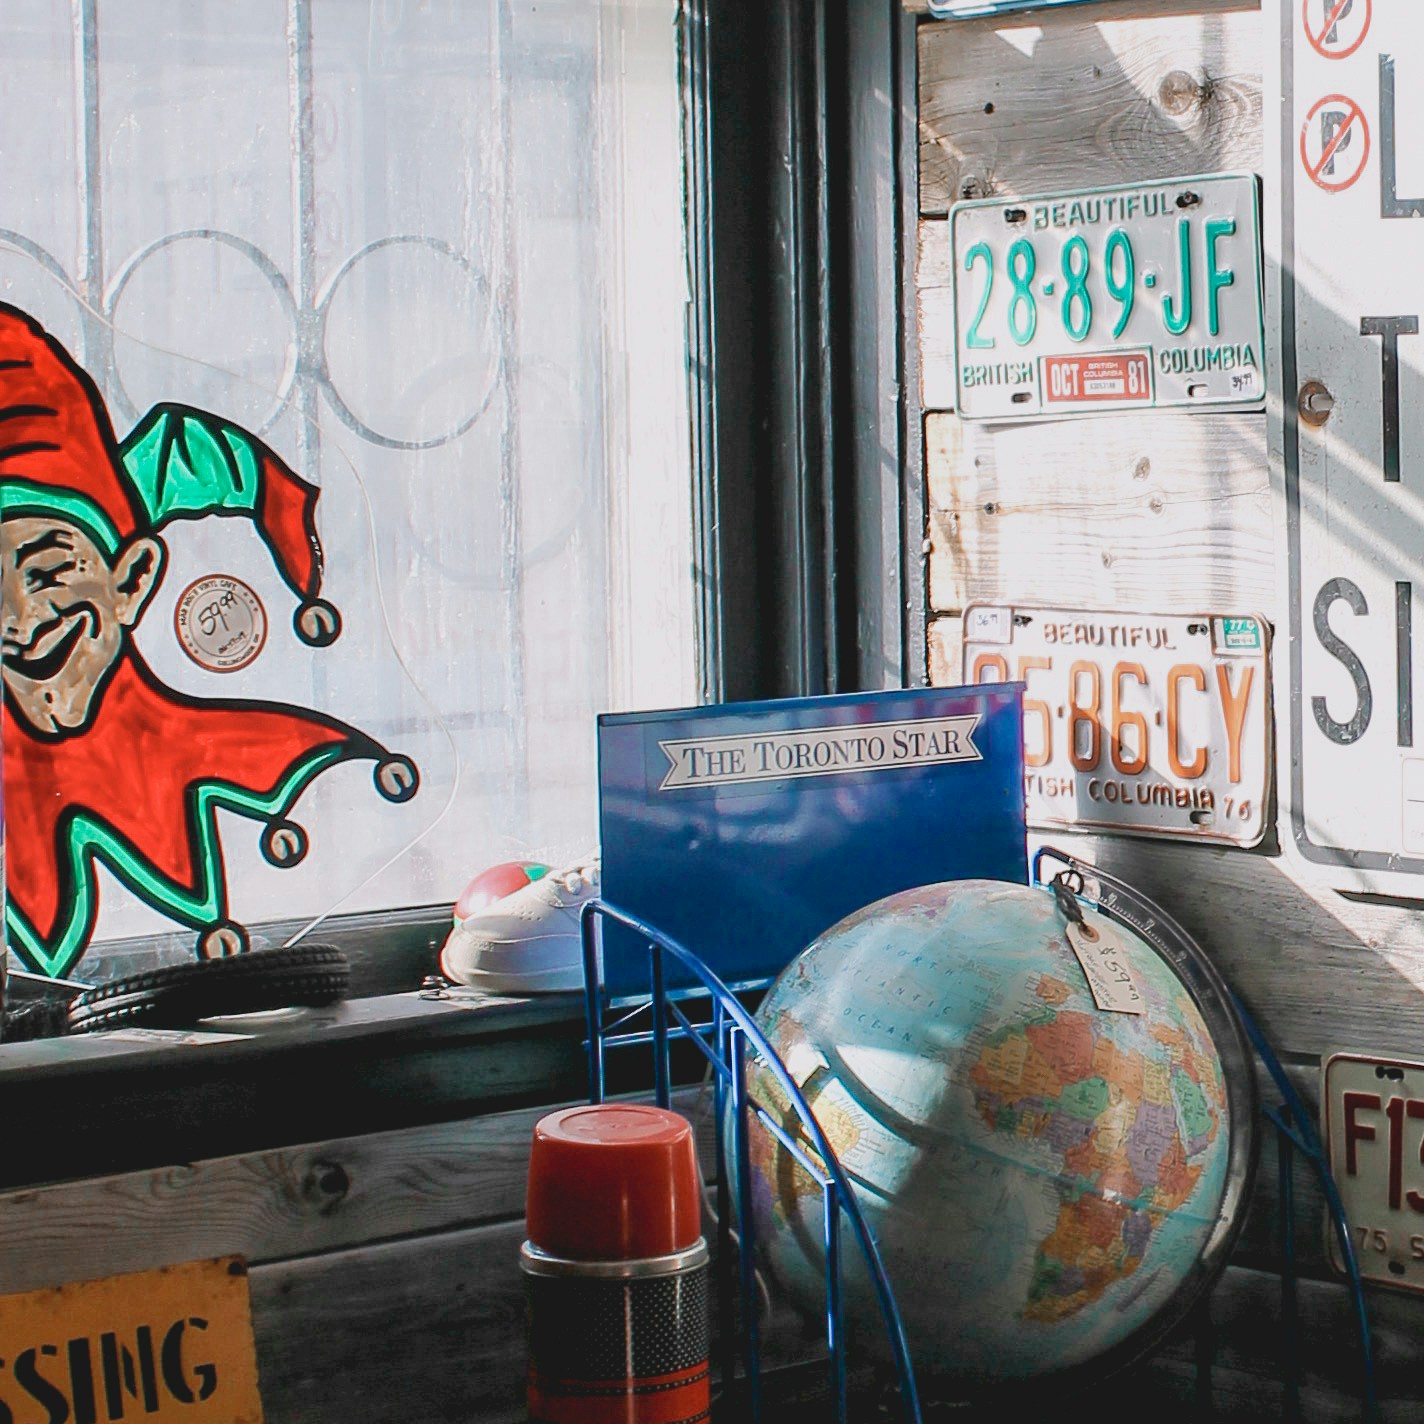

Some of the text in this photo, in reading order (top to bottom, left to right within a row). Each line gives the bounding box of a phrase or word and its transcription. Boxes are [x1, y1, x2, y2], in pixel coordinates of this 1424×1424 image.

[1033, 190, 1174, 231] BEAUTIFUL
[963, 342, 1257, 387] BRITISH COLUMBIA
[1051, 360, 1146, 396] OCT 81
[1043, 622, 1177, 651] BEAUTIFUL
[681, 728, 962, 778] THE TORONTO STAR
[1088, 777, 1216, 809] COLUMBIA
[1357, 1226, 1389, 1254] 75
